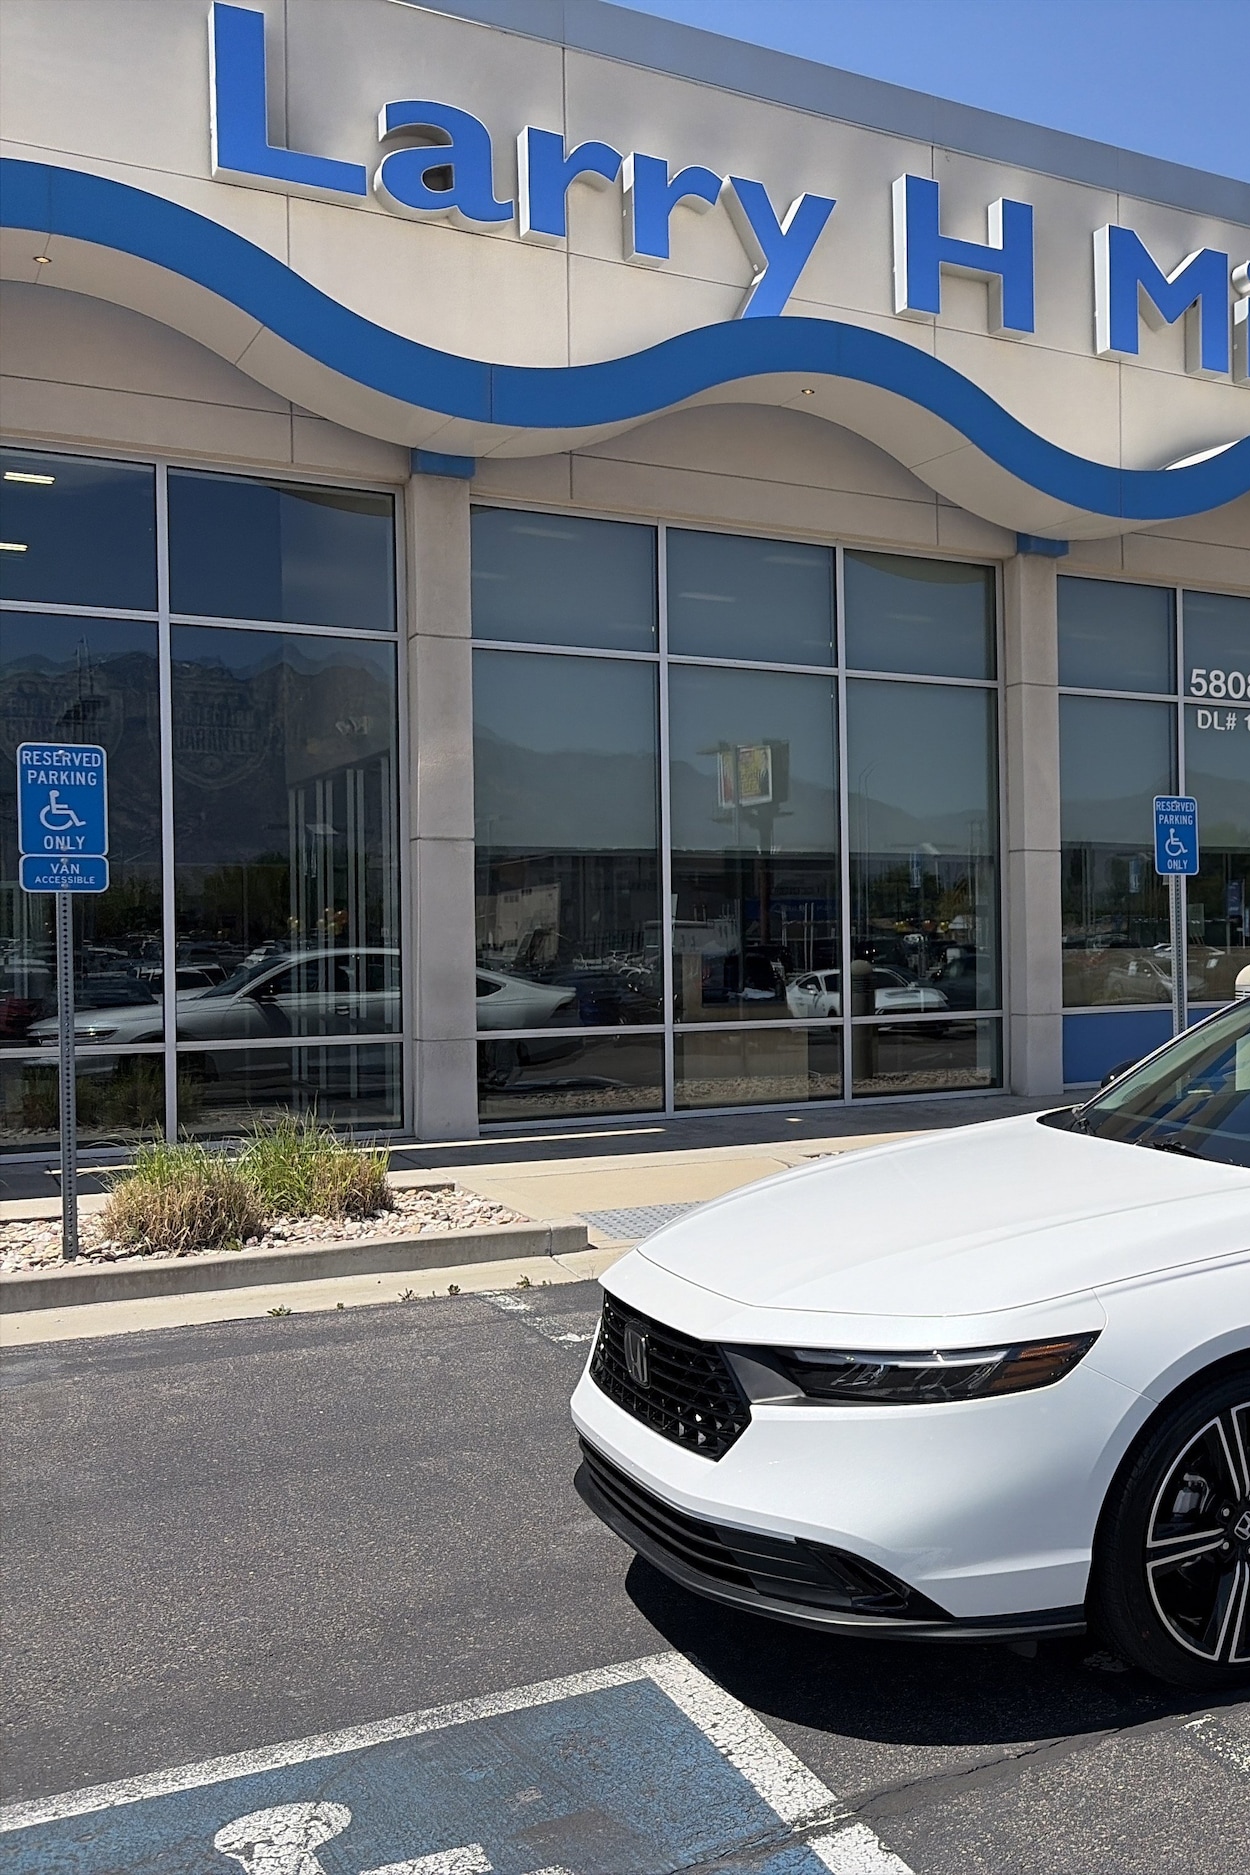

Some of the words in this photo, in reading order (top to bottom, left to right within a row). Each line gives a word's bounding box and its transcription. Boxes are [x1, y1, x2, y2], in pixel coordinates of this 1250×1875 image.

[209, 2, 834, 319] Larry
[894, 174, 1034, 338] H
[1197, 709, 1237, 731] DL#
[22, 751, 101, 767] RESERVED
[28, 770, 97, 786] PARKING
[1156, 801, 1195, 812] RESERVED
[1159, 814, 1193, 825] PARKING
[44, 835, 85, 850] ONLY
[51, 863, 80, 874] VAN
[1167, 859, 1188, 870] ONLY
[35, 876, 95, 885] ACCESSIBLE
